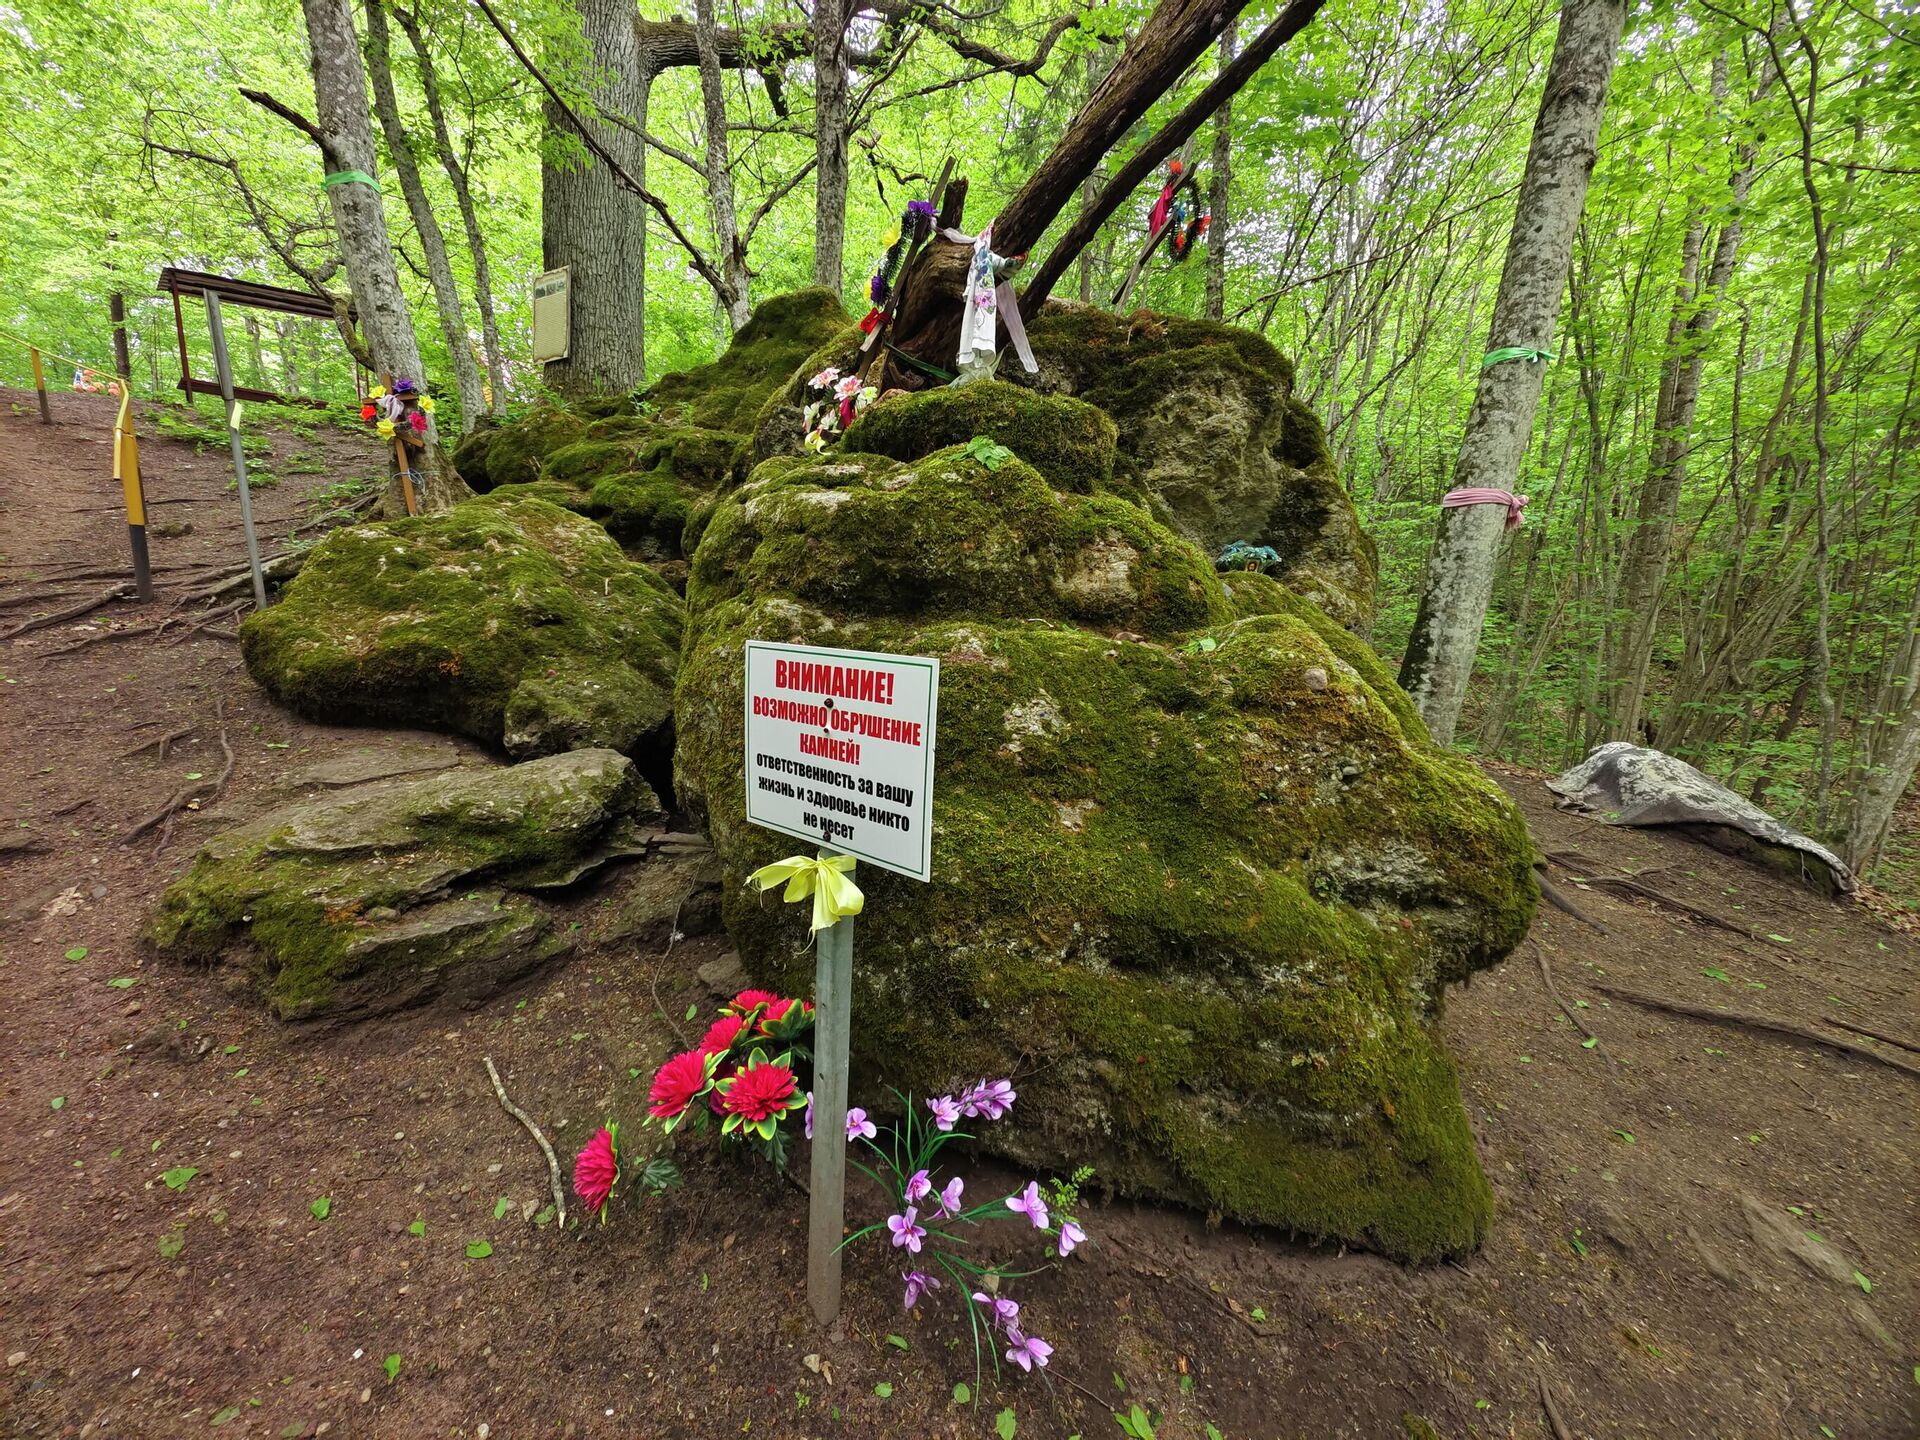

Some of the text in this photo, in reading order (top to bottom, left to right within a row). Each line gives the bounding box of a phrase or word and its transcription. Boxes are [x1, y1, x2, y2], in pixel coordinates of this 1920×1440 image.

[775, 659, 894, 705] ВНИМАНИЕ!
[753, 695, 921, 747] ВОЗМОЖНО ОБРУШЕНИЕ
[799, 733, 861, 765] КАМНЕЙ!
[756, 753, 913, 807] ответственность за вашу
[758, 776, 910, 832] жизнь и здоровье никто
[803, 812, 854, 840] не несет
